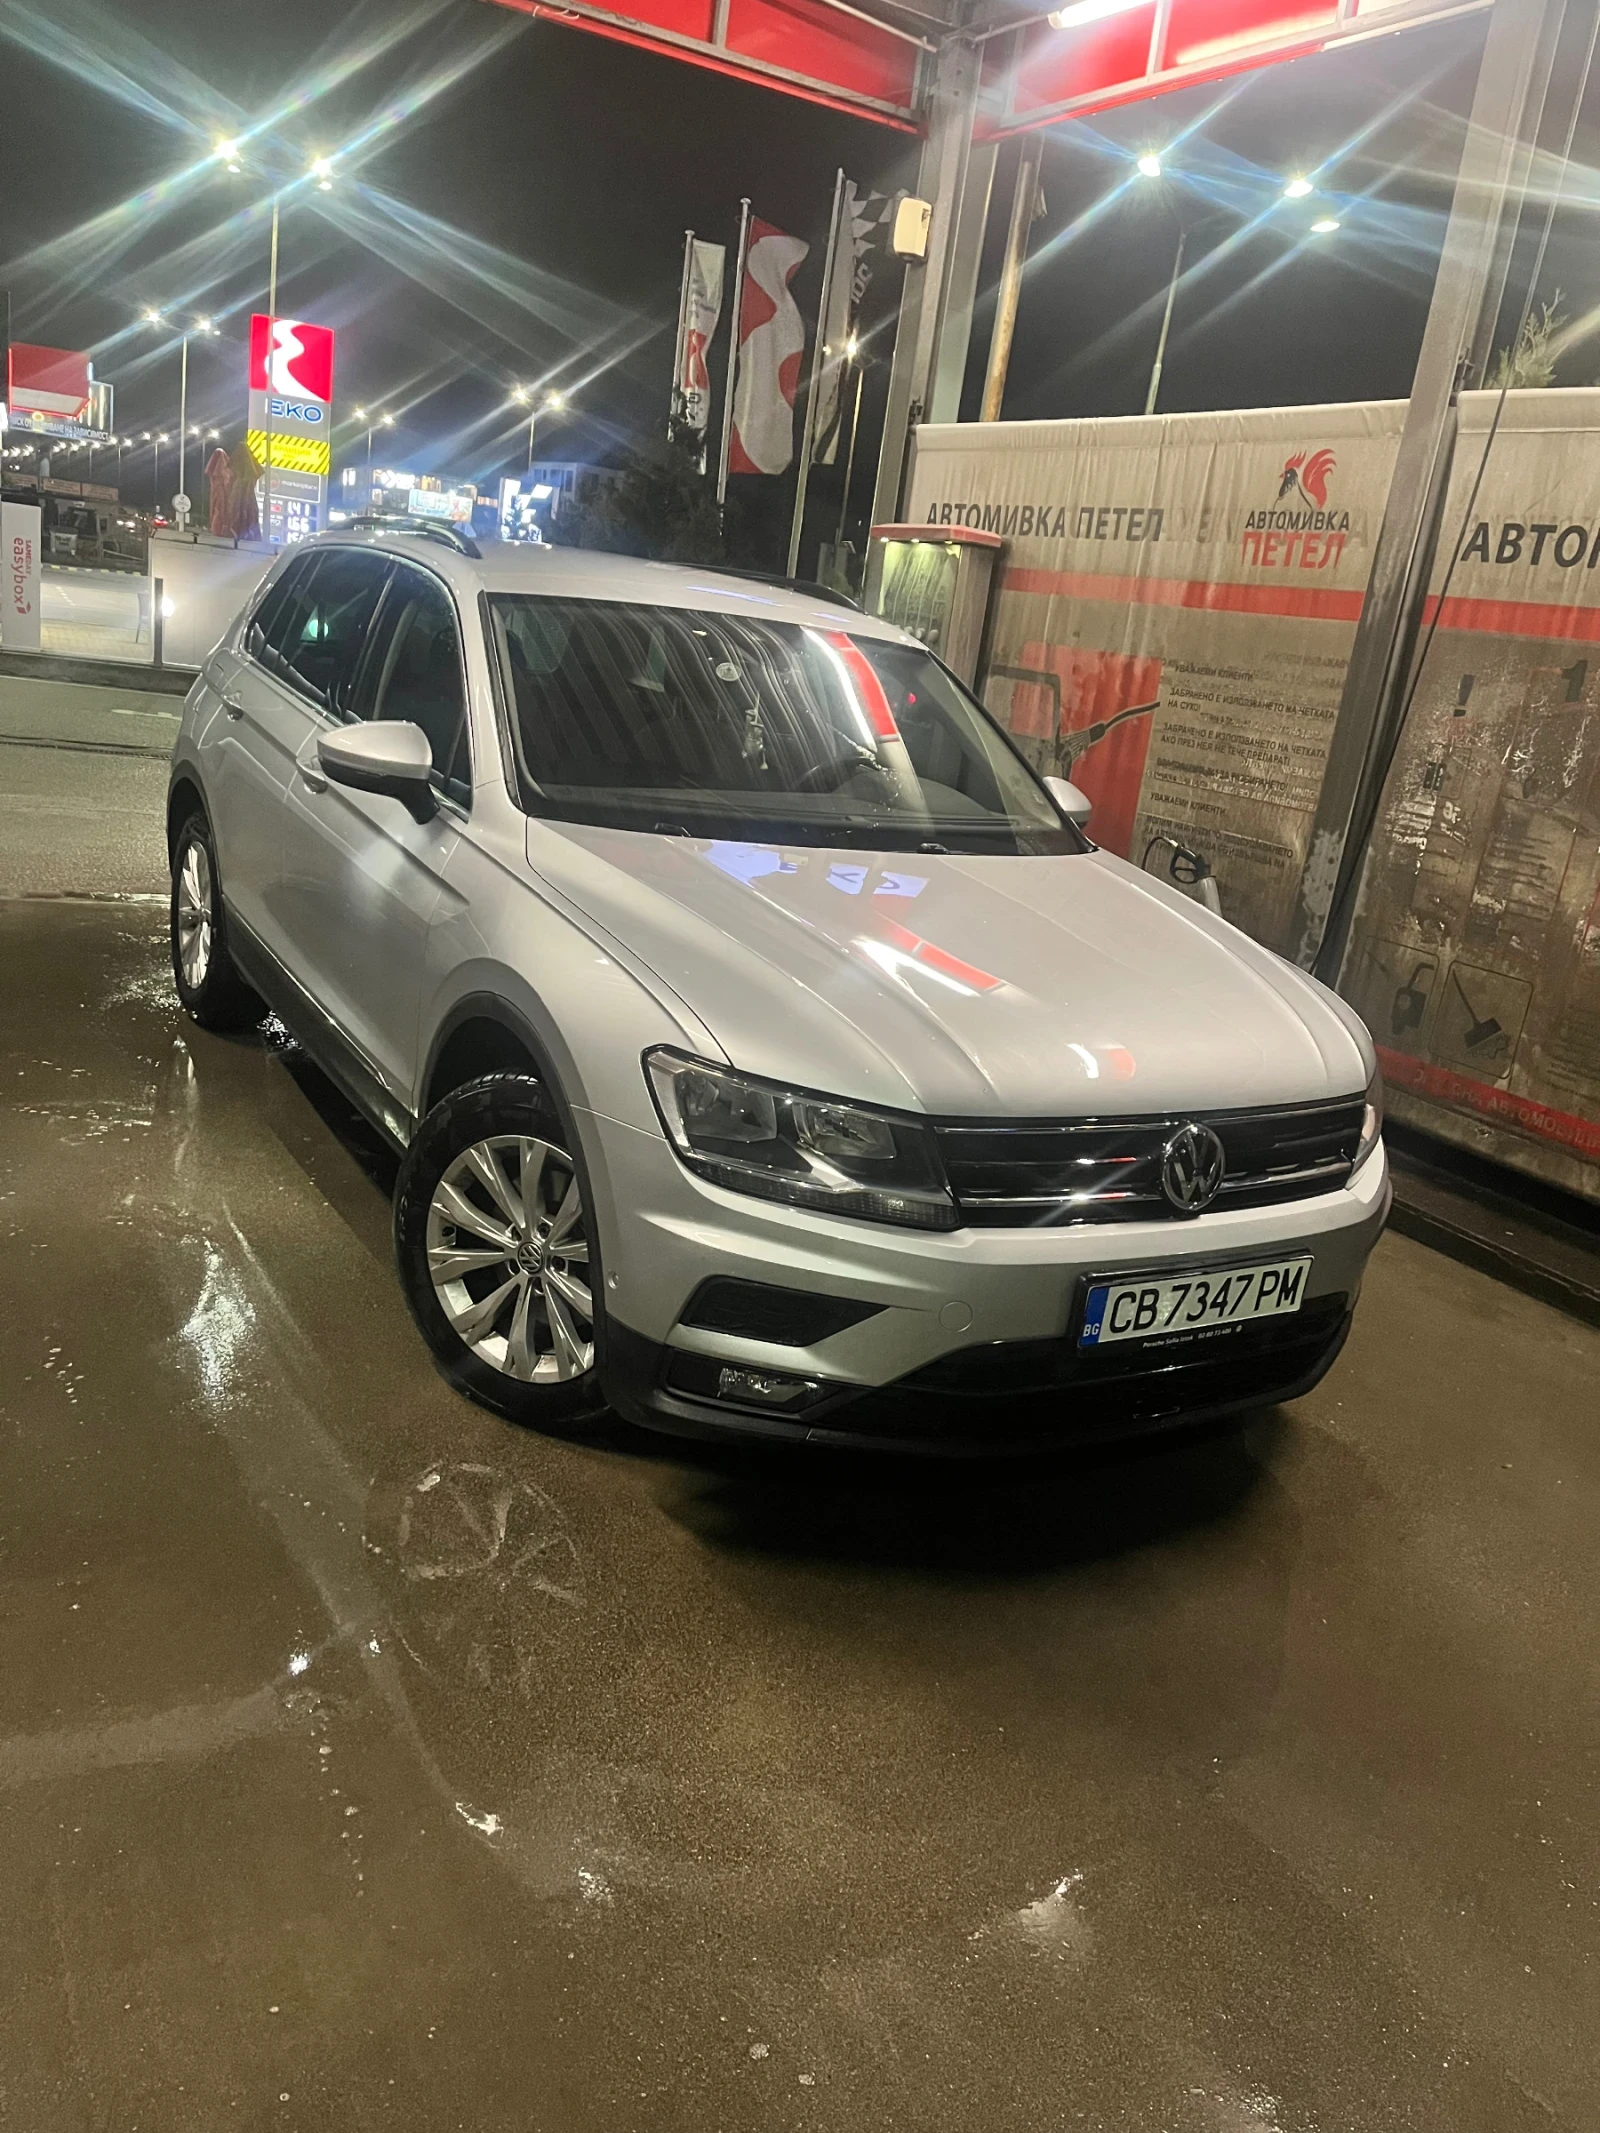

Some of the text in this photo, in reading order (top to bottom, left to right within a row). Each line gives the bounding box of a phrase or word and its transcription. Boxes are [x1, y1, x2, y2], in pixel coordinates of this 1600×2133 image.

[271, 398, 323, 422] EKO
[926, 502, 1066, 538] АВТОМИВКА
[1075, 507, 1165, 543] ПЕТЕЛ
[1245, 510, 1351, 532] АВТОМИВКА
[1241, 531, 1347, 569] ПЕТЕЛ
[10, 537, 27, 604] easybox
[1167, 699, 1179, 708] НА
[1170, 686, 1214, 702] ЗАБРАНЕНО
[1160, 734, 1176, 745] АКО
[1177, 737, 1195, 748] ПРЕЗ
[1196, 740, 1213, 751] НЕЯ
[1214, 743, 1226, 753] НЕ
[1227, 745, 1247, 757] ТЕЧЕ
[1163, 722, 1207, 738] ЗАБРАНЕНО
[1214, 731, 1277, 749] ИЗПОЛЗВАНЕТО
[1277, 740, 1289, 750] НА
[1150, 792, 1226, 815] УВАЖАЕМИ КЛИЕНТИ
[1163, 1274, 1255, 1327] 7347
[1083, 1323, 1100, 1337] BG
[1142, 1339, 1165, 1348] Porsche
